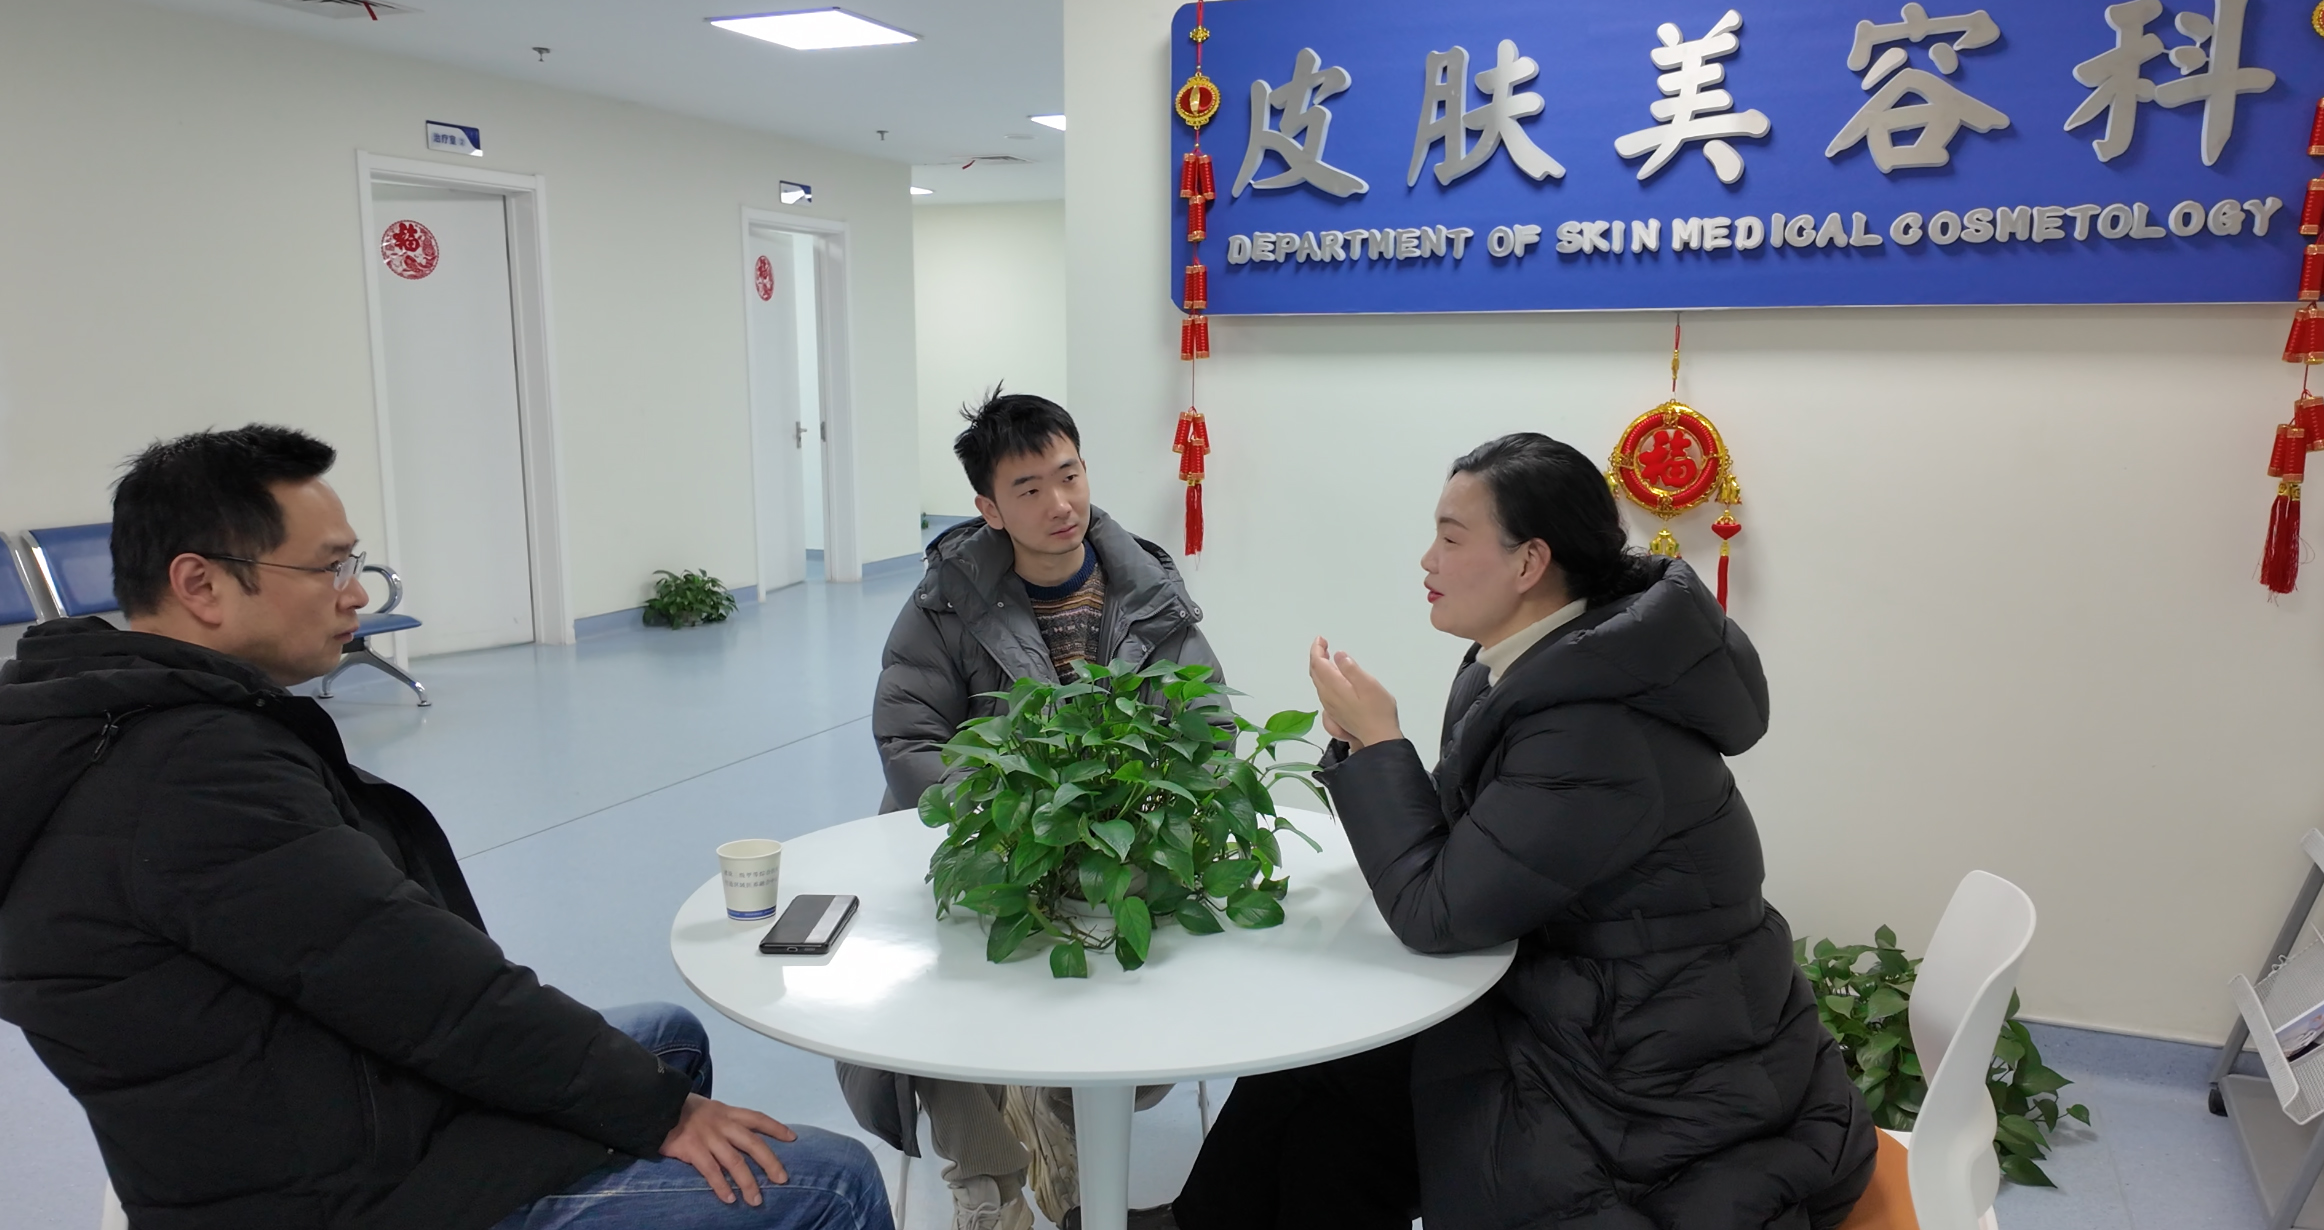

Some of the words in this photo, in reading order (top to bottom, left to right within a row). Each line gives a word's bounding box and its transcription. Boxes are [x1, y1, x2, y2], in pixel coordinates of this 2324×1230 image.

[1231, 0, 2277, 198] 皮肤美容科
[392, 222, 421, 253] 福
[1227, 225, 1474, 265] DEPARTMENT
[1486, 224, 1541, 258] OF
[1556, 219, 1661, 255] SKIN
[1671, 210, 1883, 252] MEDICAL
[1889, 197, 2283, 246] COSMETOLOGY
[1638, 429, 1698, 488] 福
